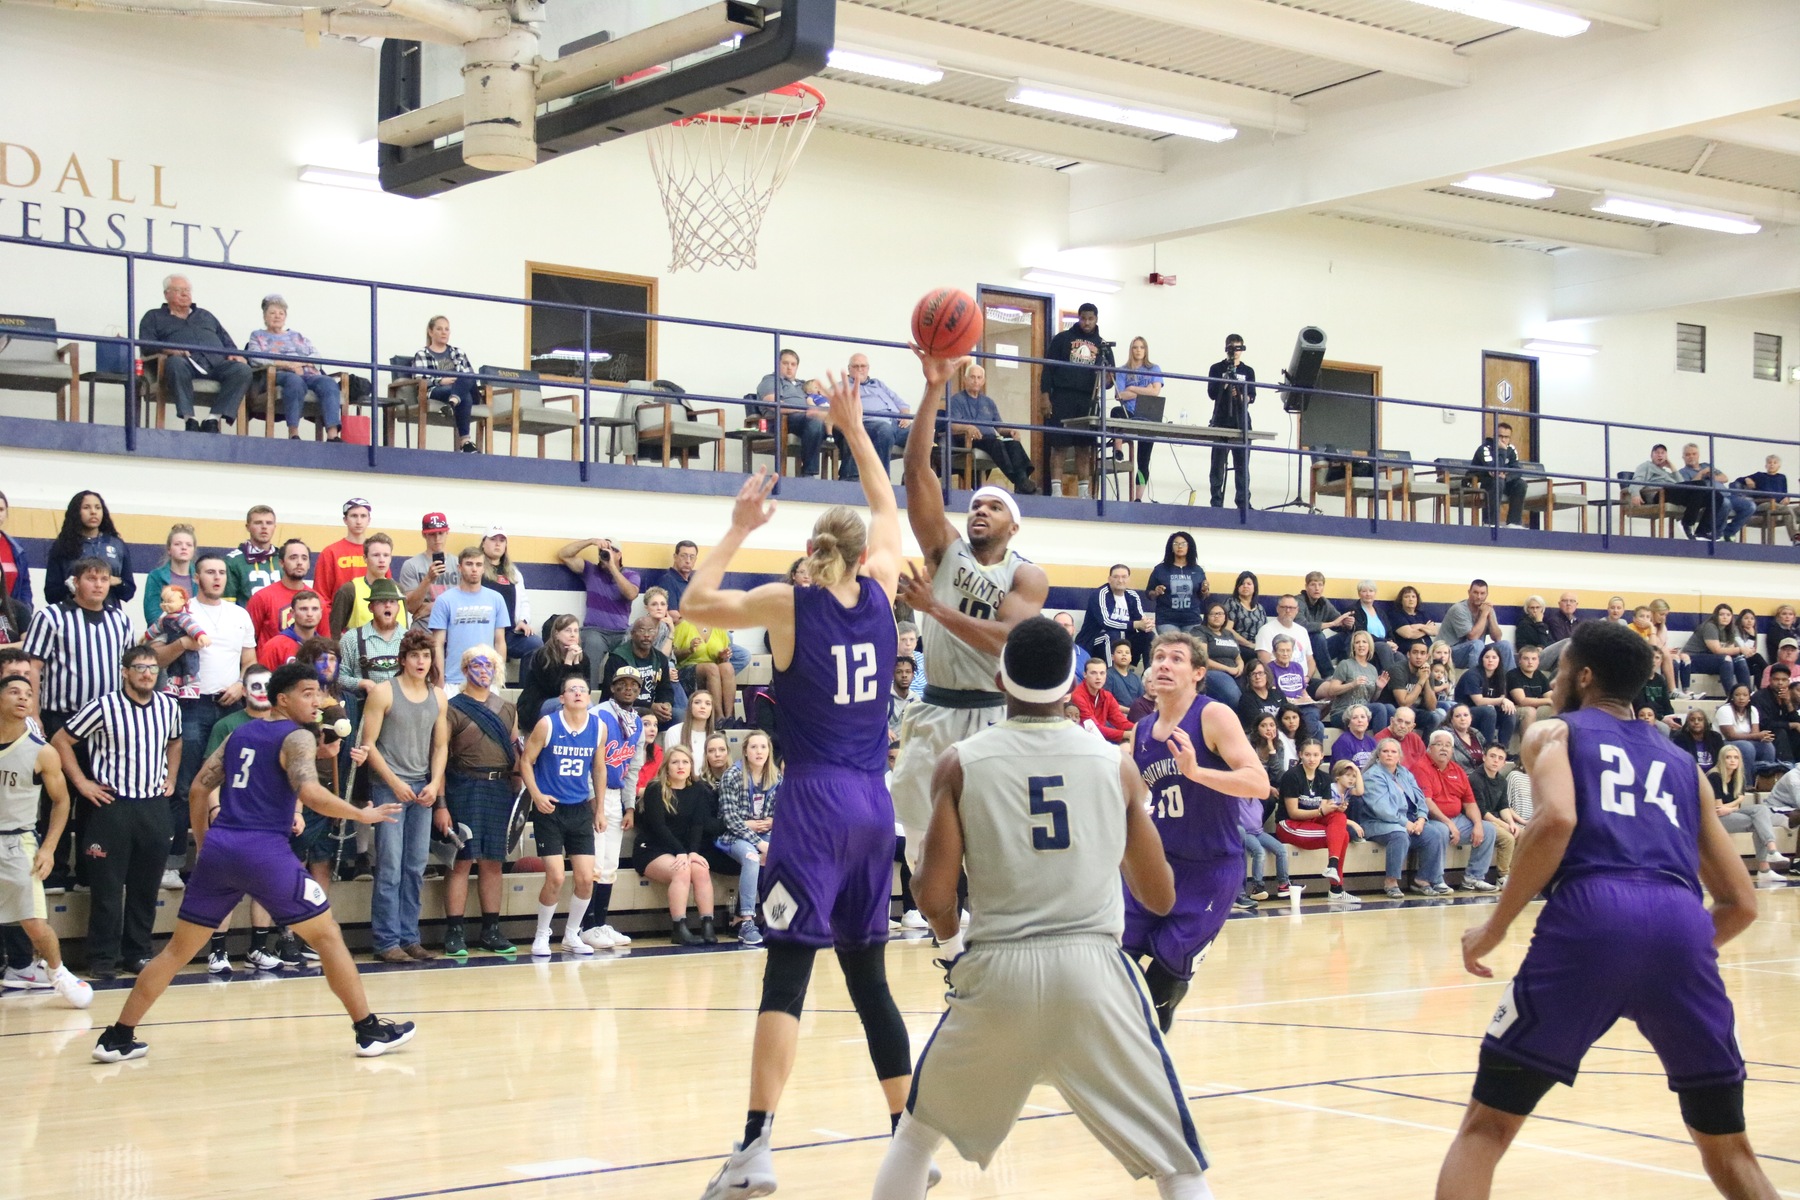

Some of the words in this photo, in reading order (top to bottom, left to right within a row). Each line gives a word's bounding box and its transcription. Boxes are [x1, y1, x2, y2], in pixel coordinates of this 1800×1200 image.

[0, 198, 243, 264] ERSITY
[953, 566, 1006, 610] SAINTS
[1171, 597, 1191, 609] BIG
[831, 642, 878, 705] 12
[232, 747, 256, 789] 3
[553, 745, 594, 757] KENTUCKY
[559, 758, 585, 777] 23
[605, 740, 636, 766] Cubs
[1599, 743, 1680, 828] 24
[1027, 774, 1071, 851] 5
